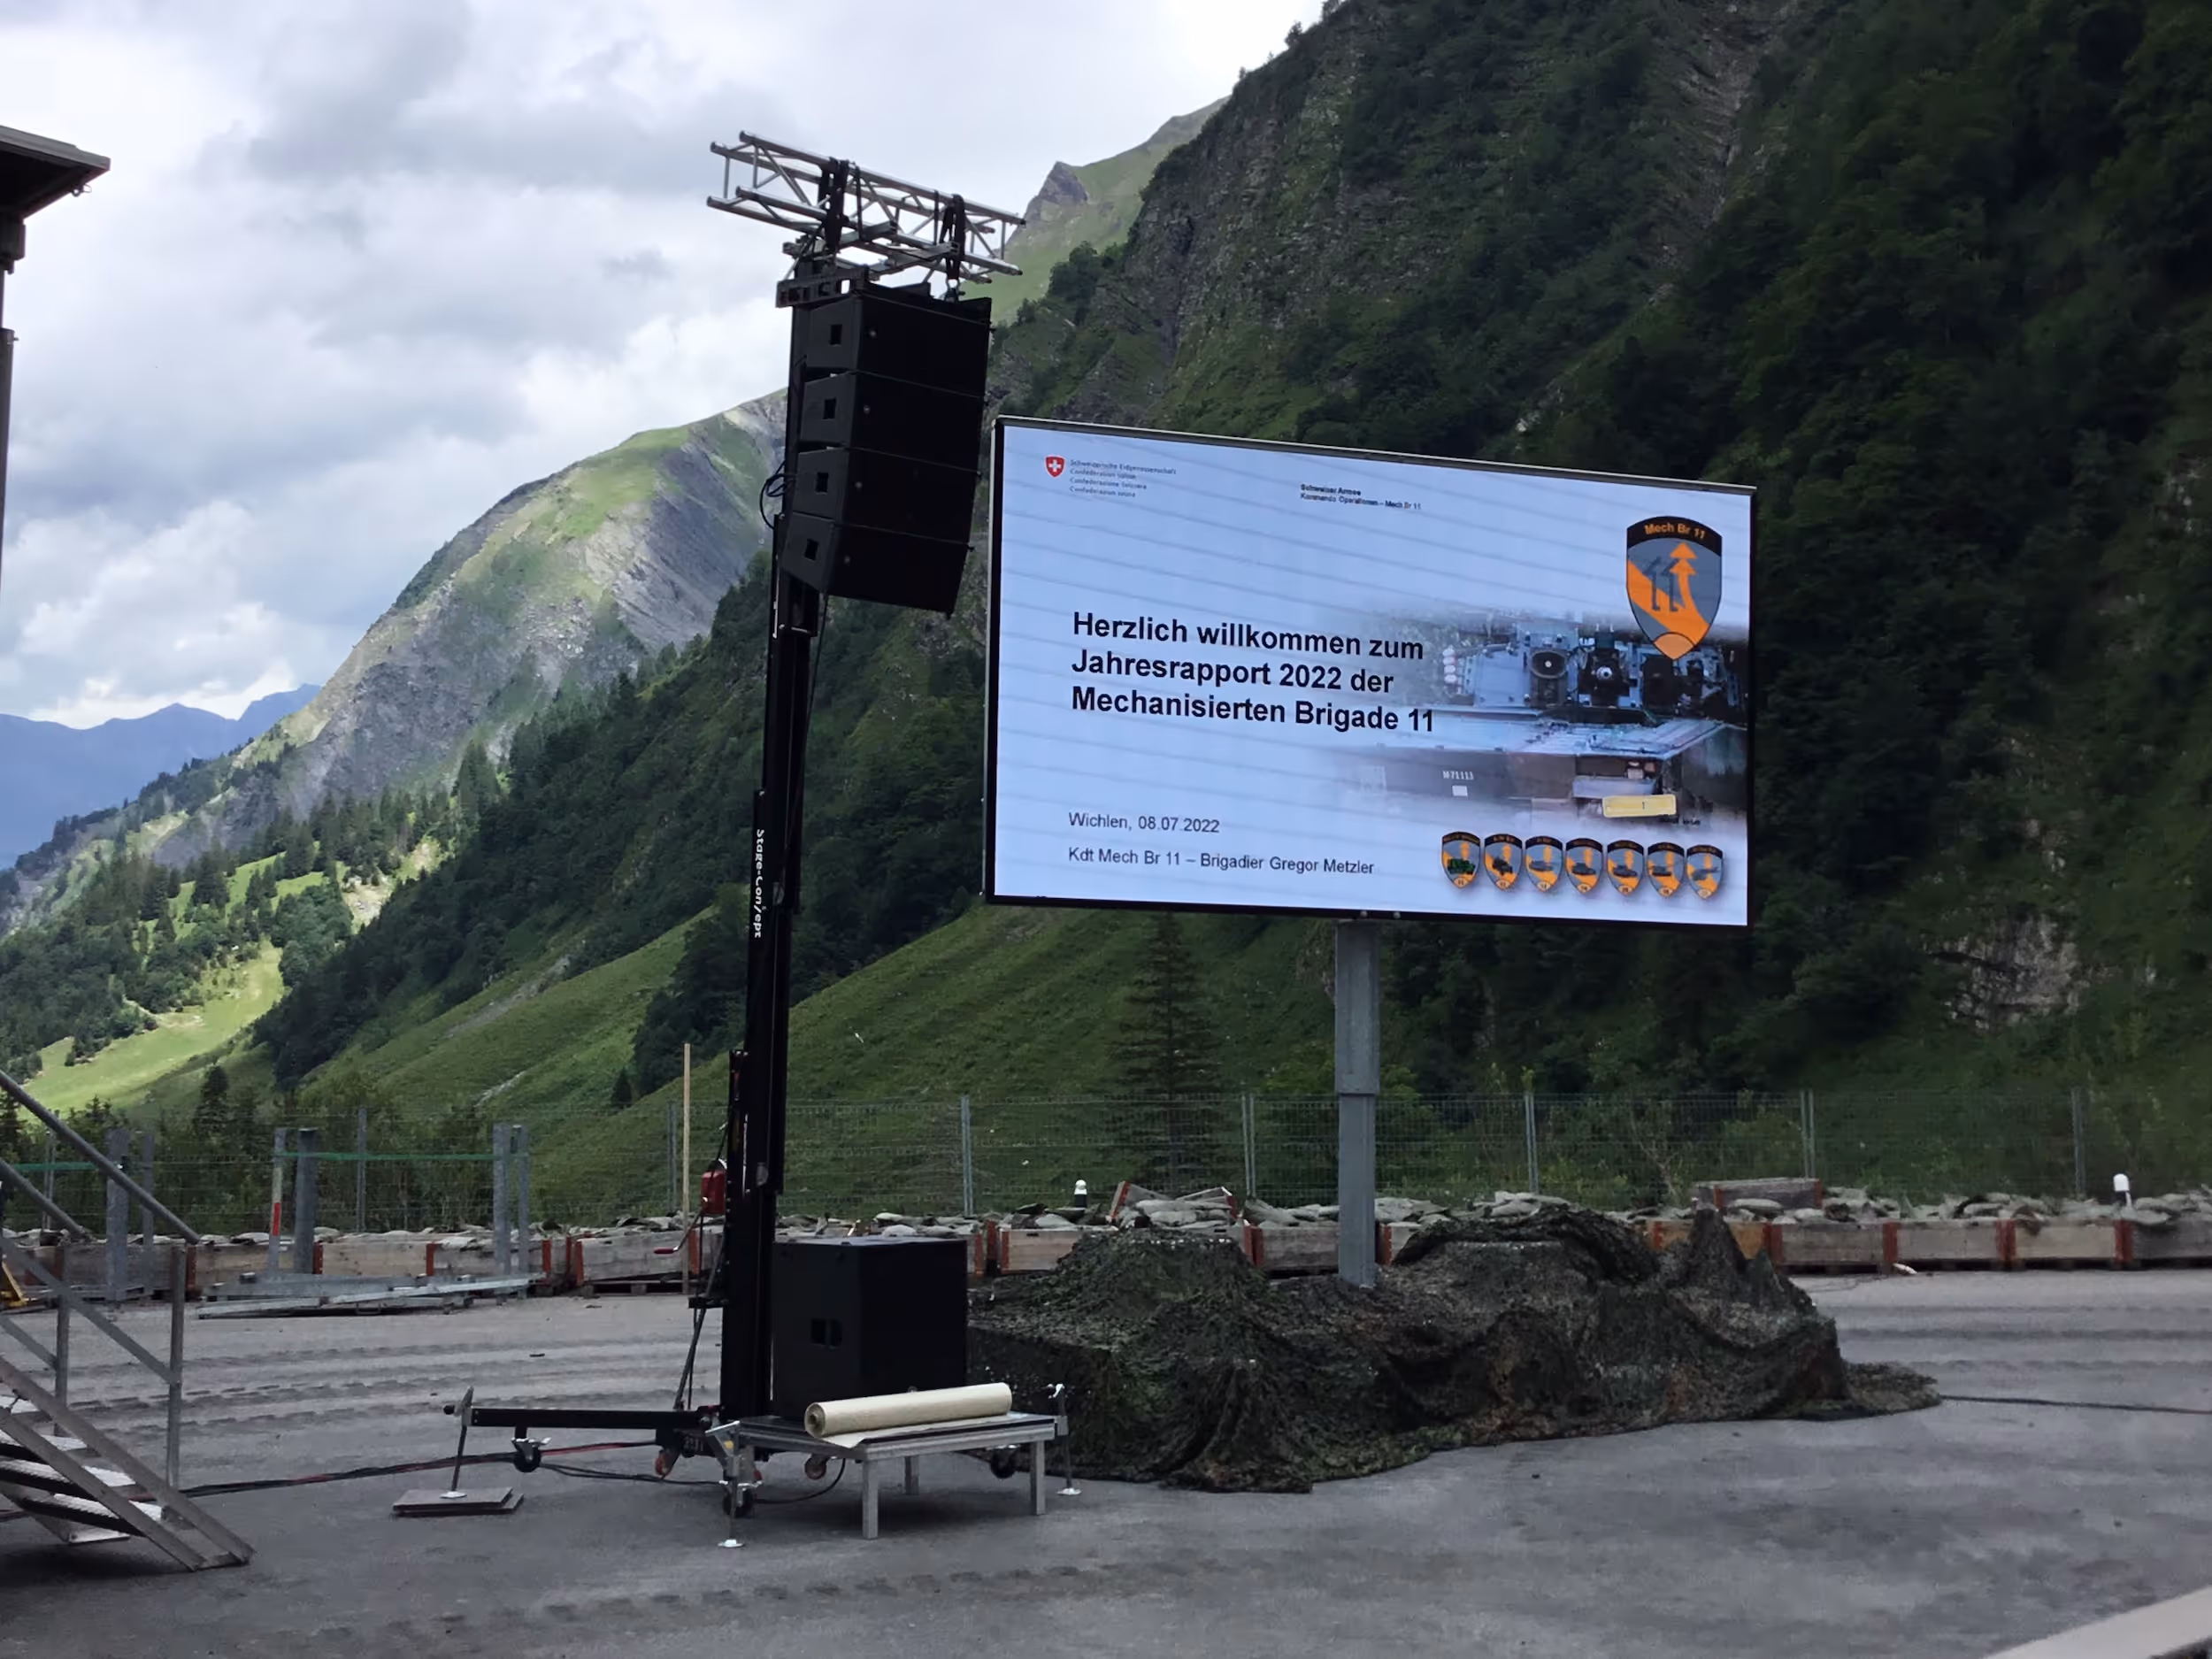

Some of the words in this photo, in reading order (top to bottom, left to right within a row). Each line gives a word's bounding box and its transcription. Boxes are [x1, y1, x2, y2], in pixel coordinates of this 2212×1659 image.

[1301, 484, 1337, 494] Schweizer
[1338, 487, 1362, 495] Armee
[1301, 493, 1337, 503] Kommando
[1339, 495, 1379, 505] Operationen
[1385, 500, 1402, 509] Mech
[1644, 522, 1674, 535] Mech
[1677, 523, 1691, 534] Br
[1694, 528, 1706, 539] 11
[1073, 611, 1187, 644] Herzlich
[1196, 622, 1361, 656] willkommen
[1369, 638, 1424, 659] zum
[1071, 649, 1271, 687] Jahresrapport
[1279, 664, 1341, 690] 2022
[1350, 669, 1394, 694] der
[1071, 686, 1286, 723] Mechanisierten
[1295, 700, 1399, 733] Brigade
[1409, 709, 1433, 732] 11
[1069, 812, 1133, 832] Wichlen,
[1138, 816, 1220, 833] 08.07.2022
[1069, 847, 1094, 863] Kdt
[1099, 849, 1138, 864] Mech
[1144, 850, 1161, 864] Br
[1165, 851, 1180, 866] 11
[1201, 853, 1264, 872] Brigadier
[1270, 856, 1319, 875] Gregor
[1324, 858, 1374, 875] Metzler
